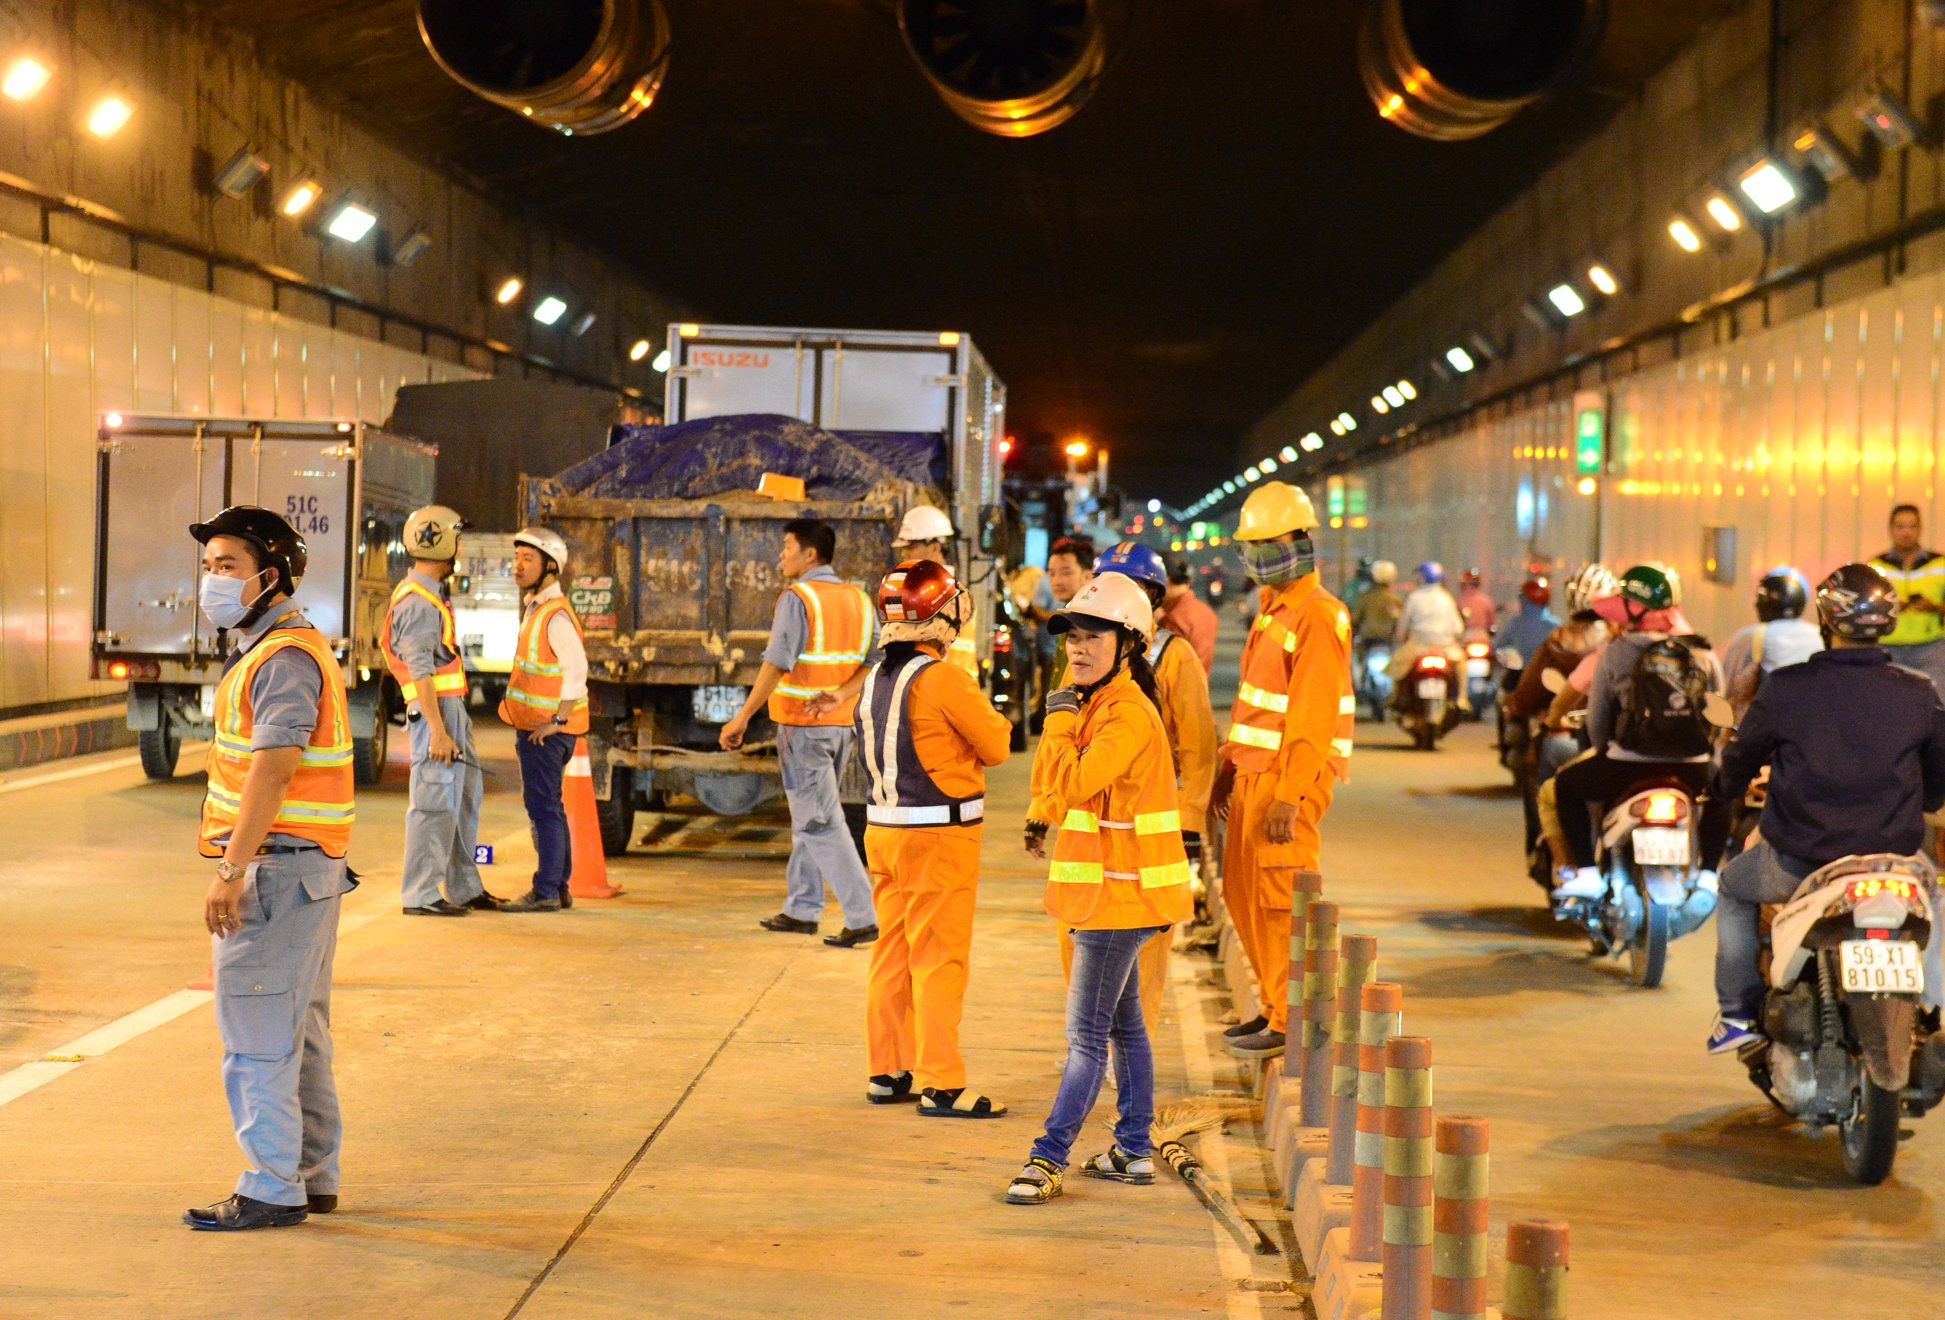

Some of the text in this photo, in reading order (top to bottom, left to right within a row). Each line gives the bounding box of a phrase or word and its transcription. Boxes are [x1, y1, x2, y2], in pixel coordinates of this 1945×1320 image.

[693, 352, 769, 368] ISUZU
[287, 494, 318, 515] 51C
[475, 846, 489, 864] 2
[1853, 945, 1905, 965] 59-X1
[1848, 967, 1917, 988] 810.15
